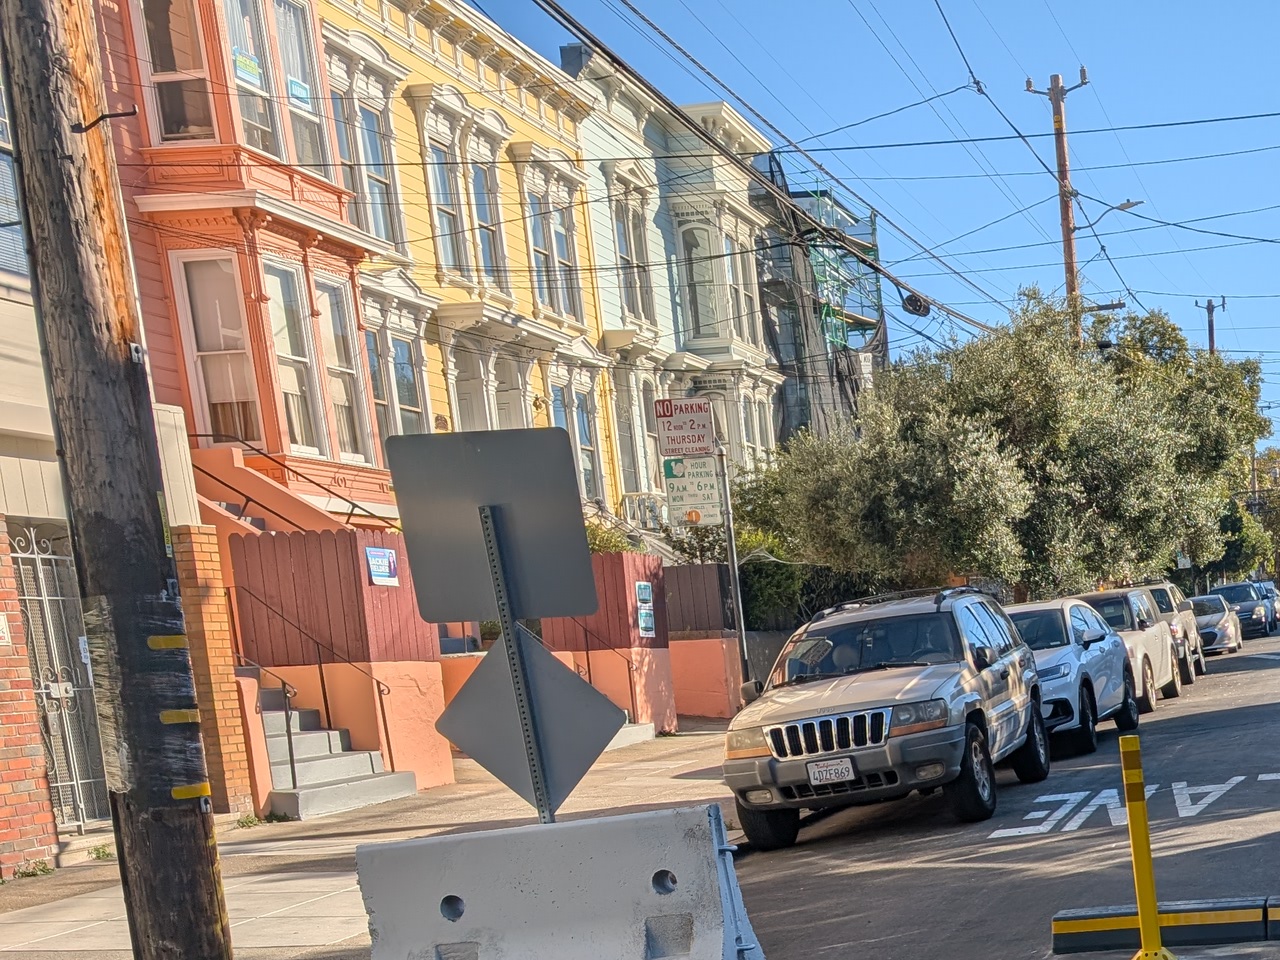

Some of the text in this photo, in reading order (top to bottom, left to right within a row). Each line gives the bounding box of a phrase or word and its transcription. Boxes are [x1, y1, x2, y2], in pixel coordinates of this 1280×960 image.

[656, 401, 709, 418] NO PARKING
[662, 420, 673, 432] 12
[689, 419, 696, 430] 2
[666, 434, 706, 445] THURSDAY
[665, 445, 711, 455] STREET CLEANING
[690, 461, 707, 469] HOUR
[688, 470, 714, 479] PARKING
[668, 483, 675, 492] 9
[697, 481, 703, 491] 6
[671, 495, 684, 503] MON
[702, 493, 713, 501] SAT
[813, 766, 850, 782] 4DZF869
